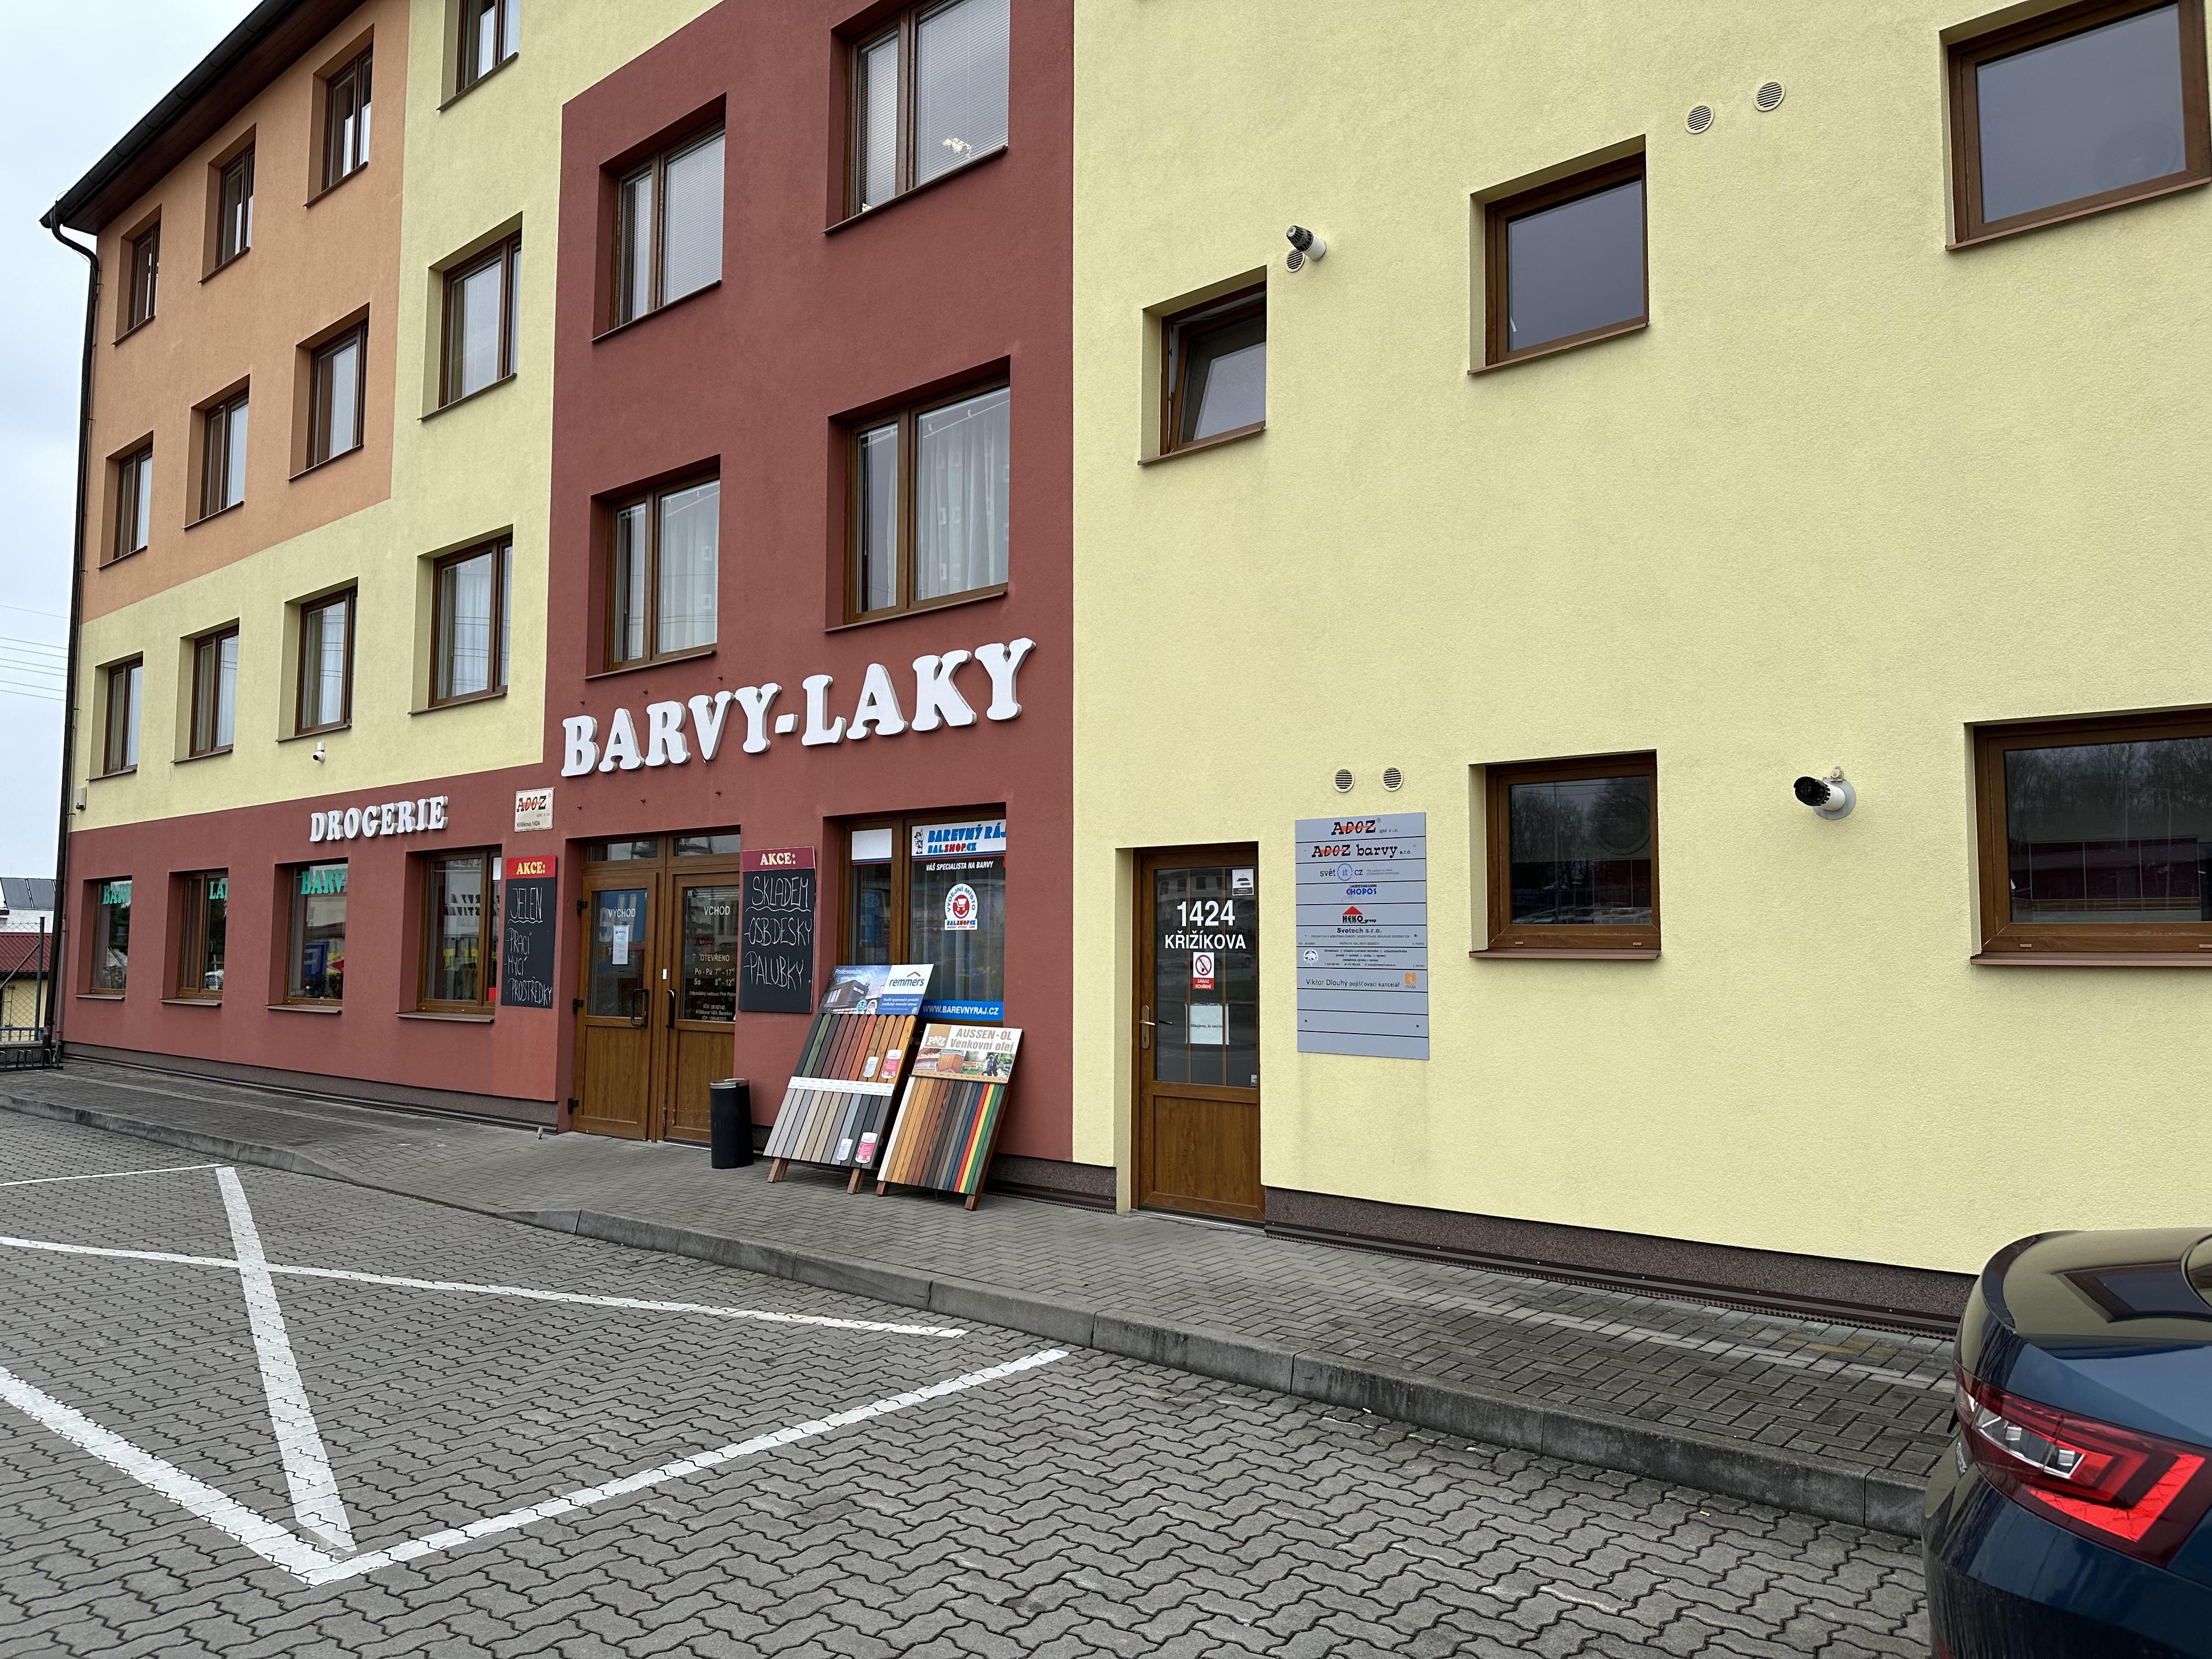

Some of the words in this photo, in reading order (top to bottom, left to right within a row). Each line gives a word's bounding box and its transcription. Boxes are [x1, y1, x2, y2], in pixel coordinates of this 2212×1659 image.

[561, 638, 1036, 776] BARVY-LAKY
[310, 796, 448, 842] DROGERIE
[927, 823, 983, 843] BAREVNÝ
[927, 842, 977, 854] BALSHOP.CZ
[1356, 844, 1398, 858] barvy
[760, 852, 796, 865] AKCE:
[516, 861, 546, 875] AKCE:
[926, 862, 936, 872] VÁŠ
[936, 862, 967, 870] SPECIALISTA
[1319, 869, 1336, 877] svět
[752, 876, 808, 908] SKLADEM
[510, 887, 542, 920] JELEN
[703, 905, 731, 915] VCHOD
[608, 906, 636, 918] VÝCHOD
[1177, 900, 1235, 927] 1424
[1165, 930, 1246, 950] KŘIŽÍKOVA
[700, 953, 730, 962] OTEVŘENO
[889, 978, 925, 987] remmers
[508, 976, 552, 1006] PROSTŘEDKY
[923, 1005, 999, 1015] WWW.BAREVNYRAJ.CZ
[926, 1035, 947, 1046] PNZ
[951, 1038, 994, 1050] Venkovní
[995, 1042, 1014, 1053] olej
